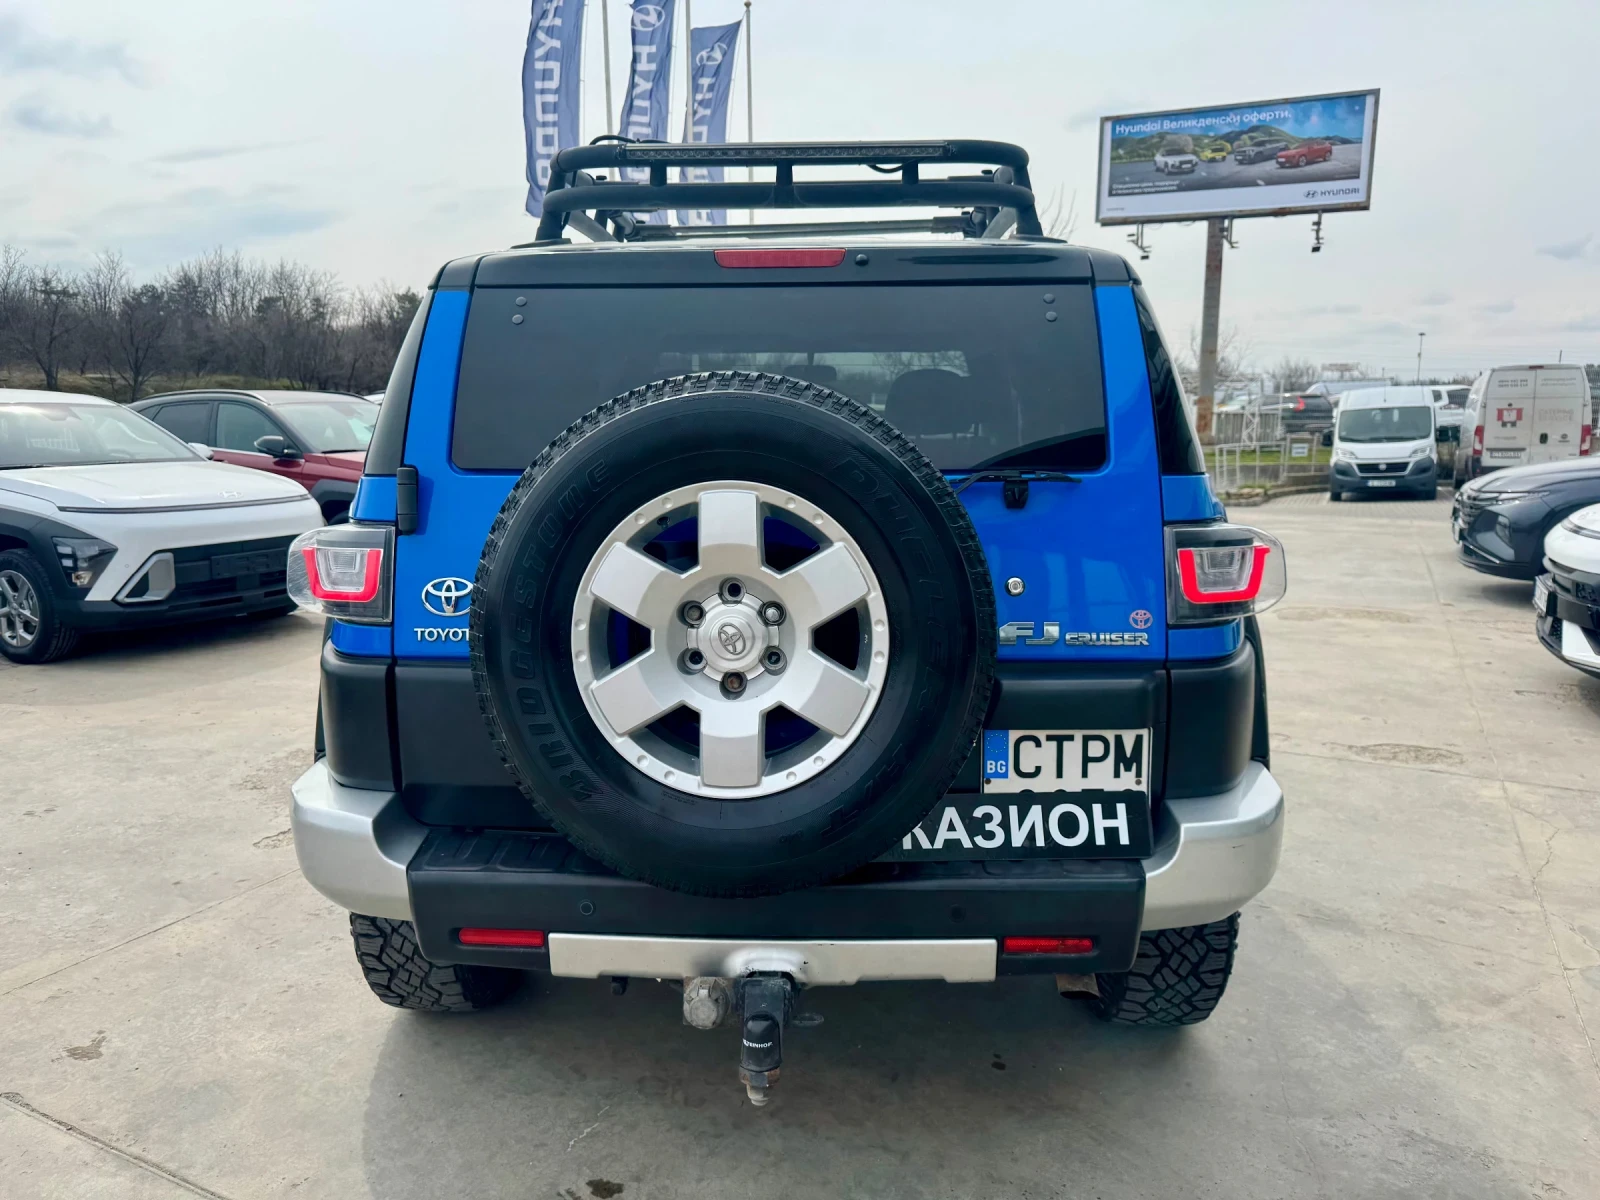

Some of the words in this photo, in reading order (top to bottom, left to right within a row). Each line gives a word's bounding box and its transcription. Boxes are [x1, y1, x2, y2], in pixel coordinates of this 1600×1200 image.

[1115, 121, 1161, 135] Hyundai
[1163, 113, 1241, 130] Великденски
[1320, 187, 1360, 197] HYUNDAI
[998, 621, 1060, 645] FJ
[1065, 632, 1150, 646] CRUISER
[986, 760, 1006, 774] BG
